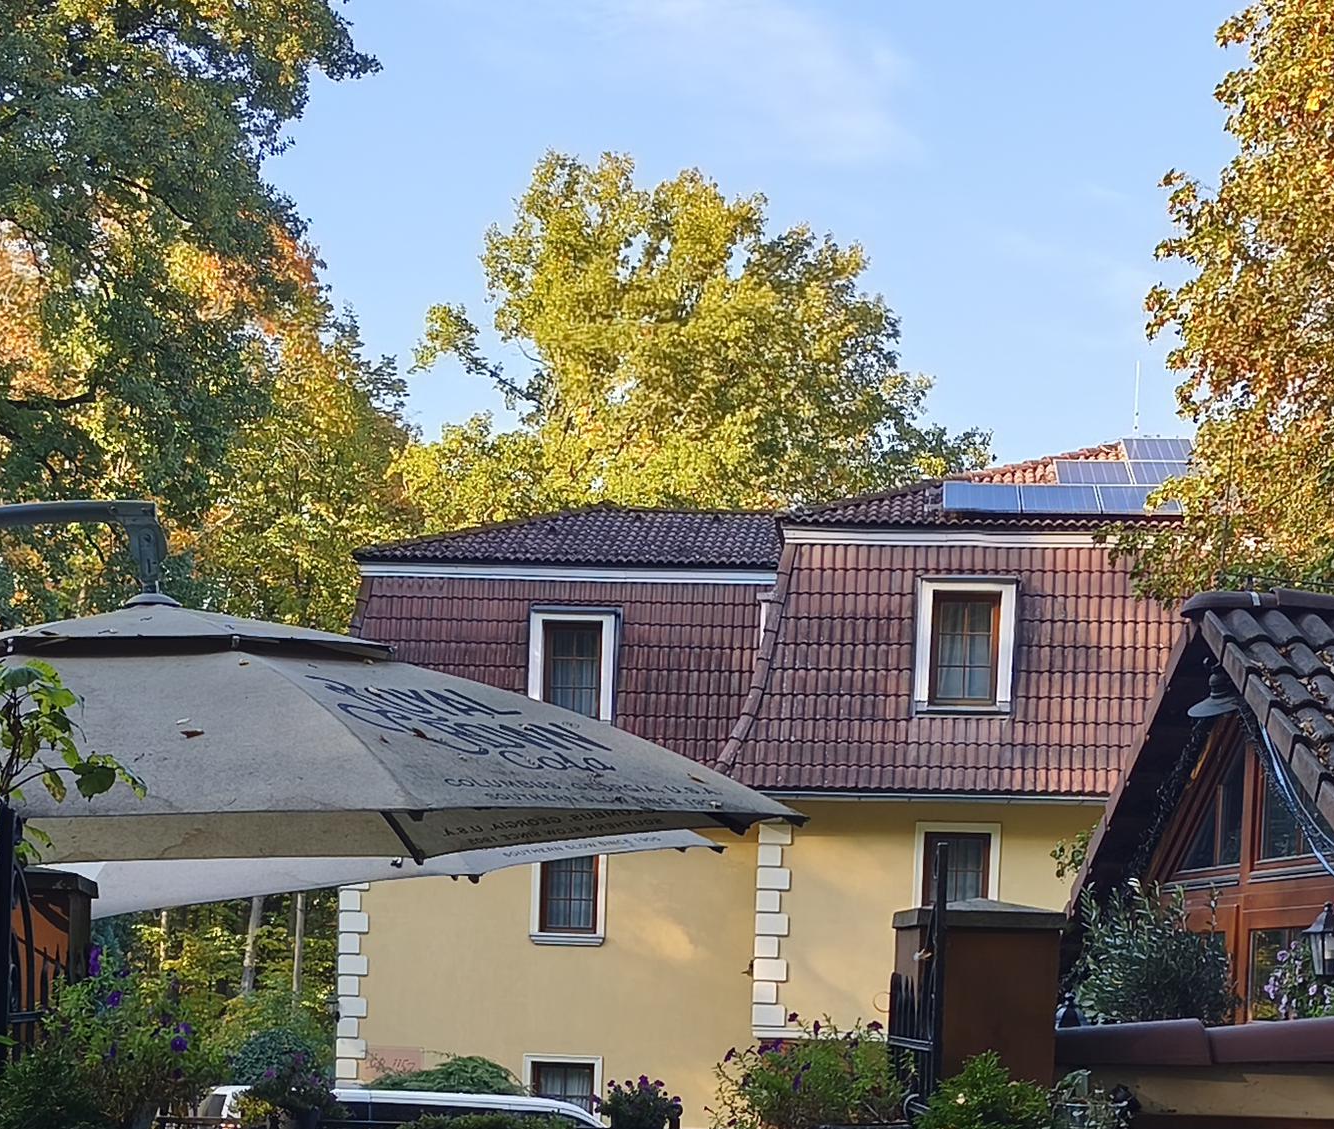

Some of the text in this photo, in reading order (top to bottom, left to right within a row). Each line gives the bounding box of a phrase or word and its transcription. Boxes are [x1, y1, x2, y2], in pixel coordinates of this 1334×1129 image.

[305, 675, 522, 722] ROYAL
[337, 703, 613, 755] CROWN
[499, 750, 617, 772] Cola
